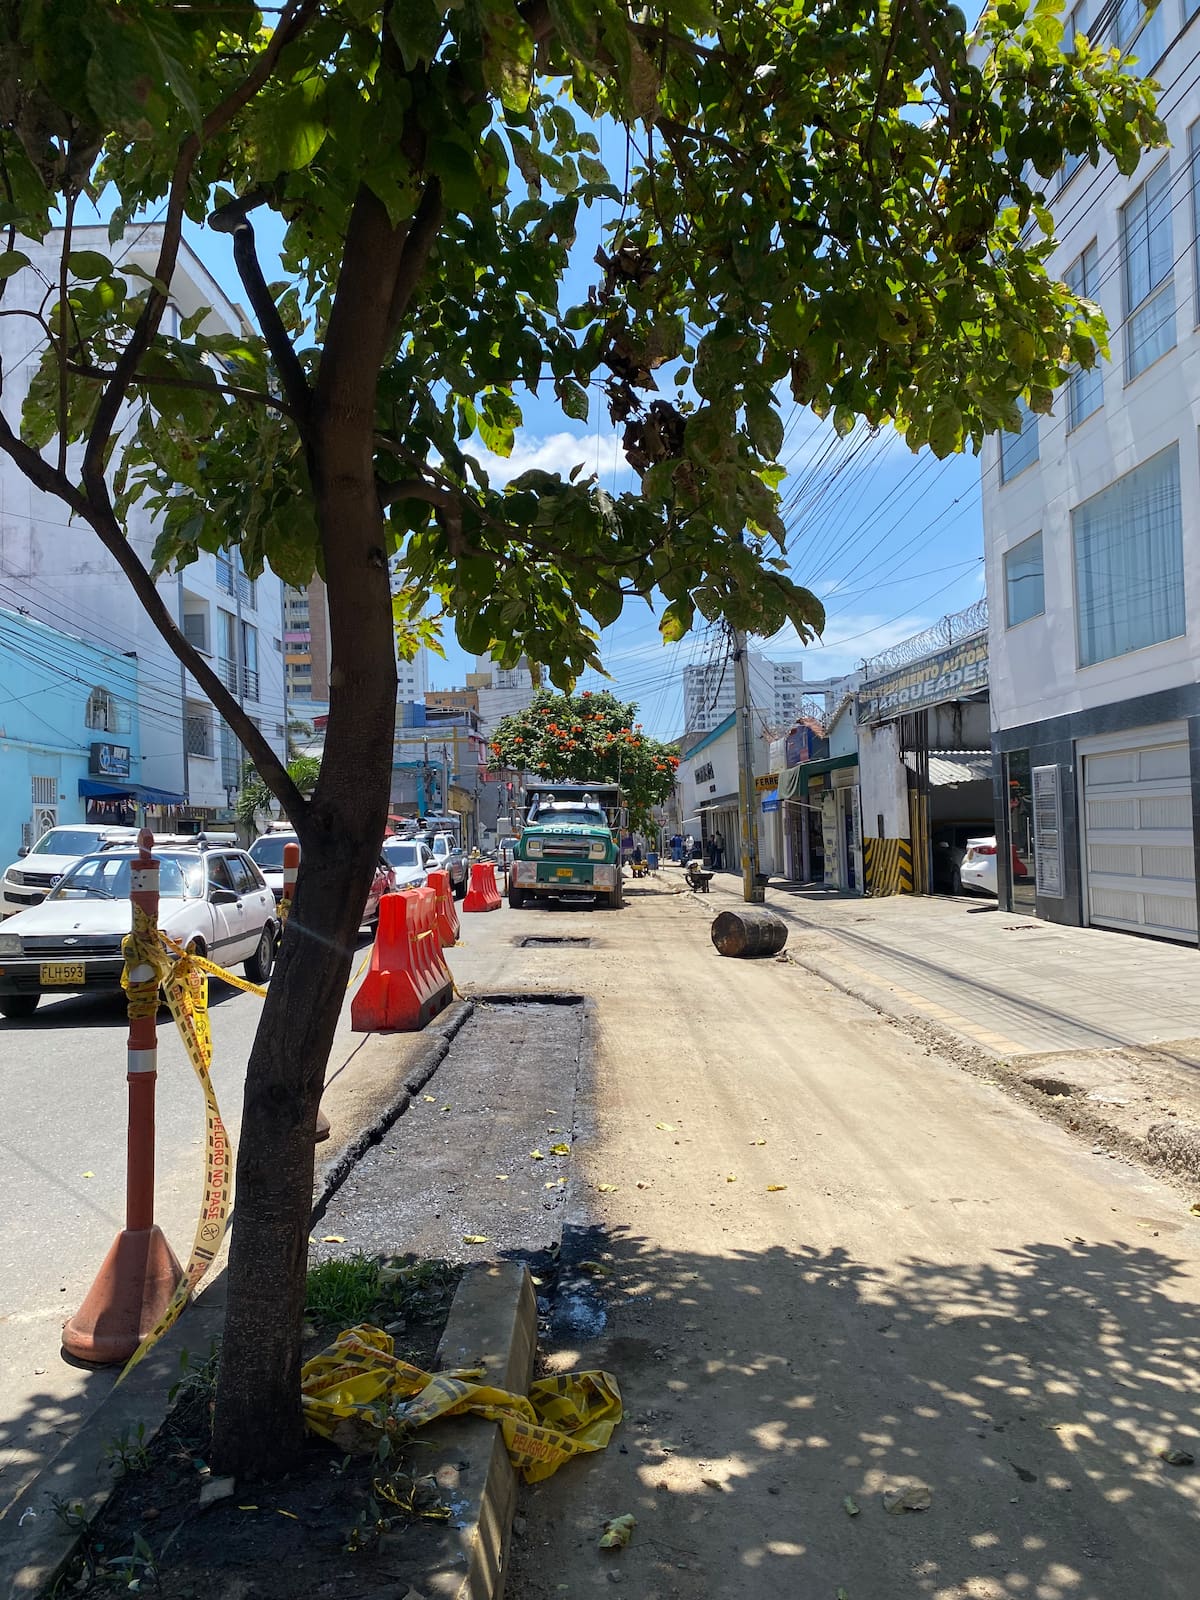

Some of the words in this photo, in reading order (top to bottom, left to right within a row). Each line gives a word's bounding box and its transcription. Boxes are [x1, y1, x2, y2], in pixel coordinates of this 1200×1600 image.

[543, 827, 592, 835] DODGE
[213, 1117, 225, 1166] PELIGRO
[212, 1170, 224, 1188] NO
[208, 1191, 222, 1220] PASE
[511, 1434, 548, 1458] PELIGRO
